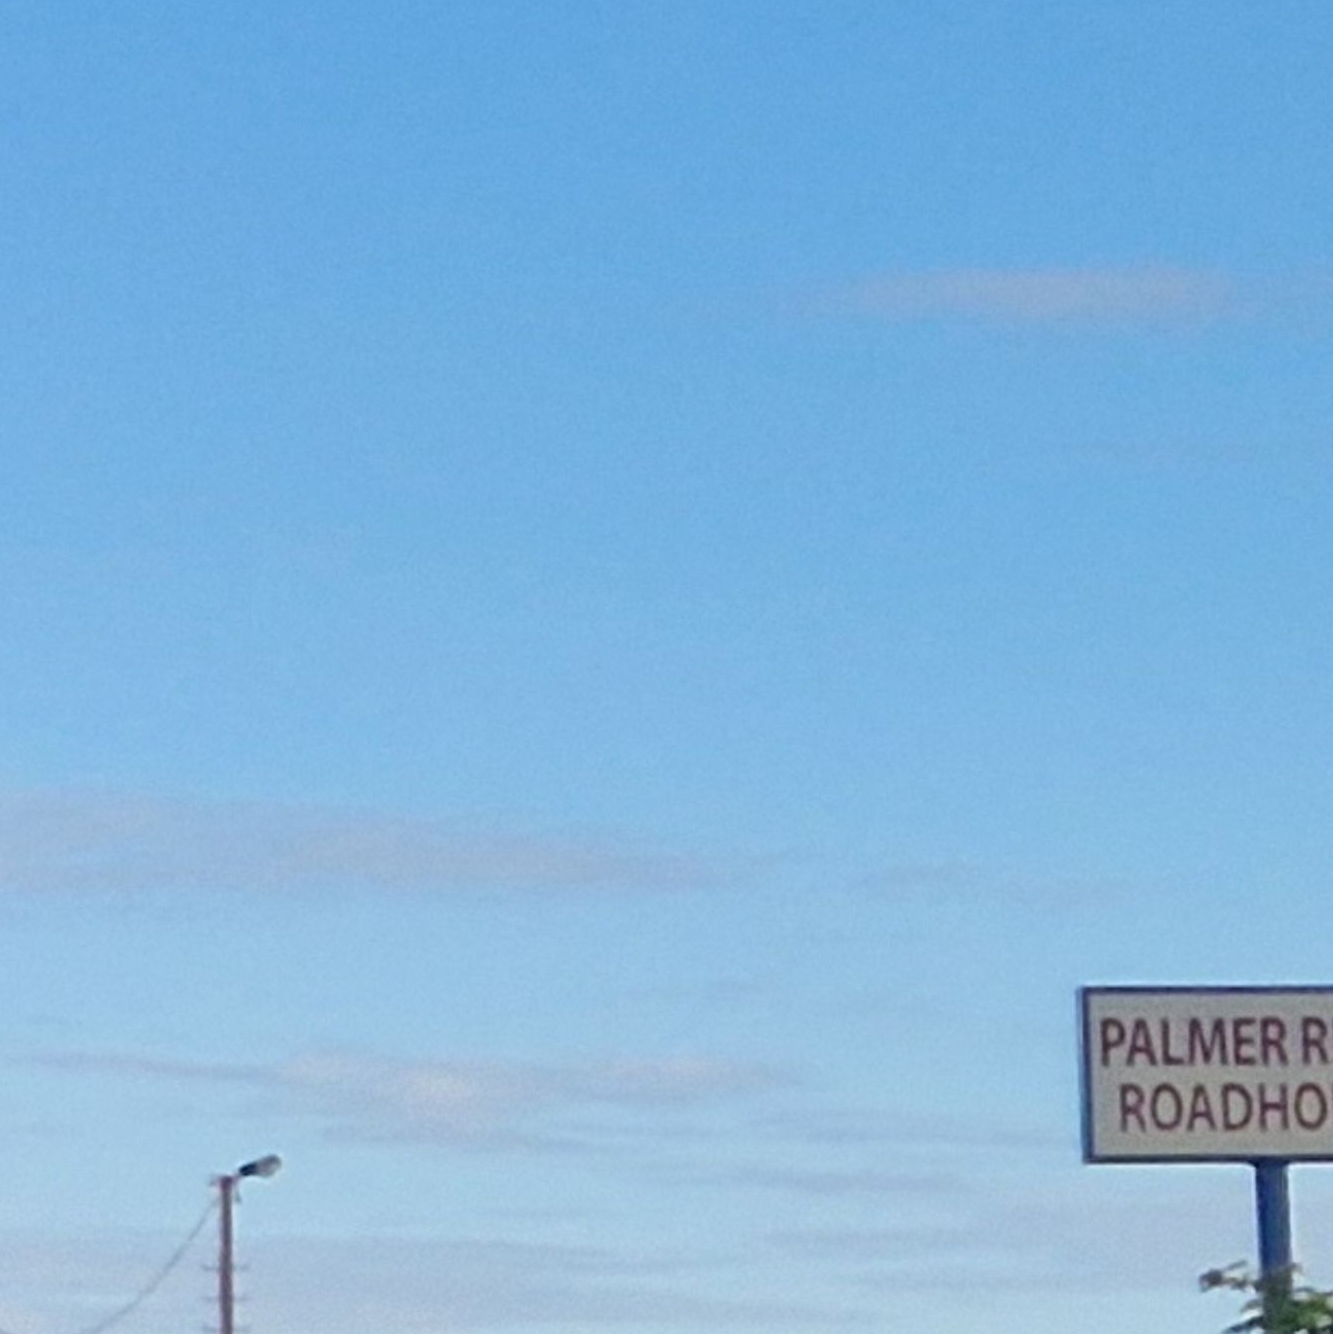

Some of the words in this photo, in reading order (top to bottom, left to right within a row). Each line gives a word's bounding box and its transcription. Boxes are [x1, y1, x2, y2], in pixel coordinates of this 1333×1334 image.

[1099, 1017, 1288, 1066] PALMER
[1301, 1017, 1333, 1065] R
[1120, 1082, 1333, 1132] ROADHO
